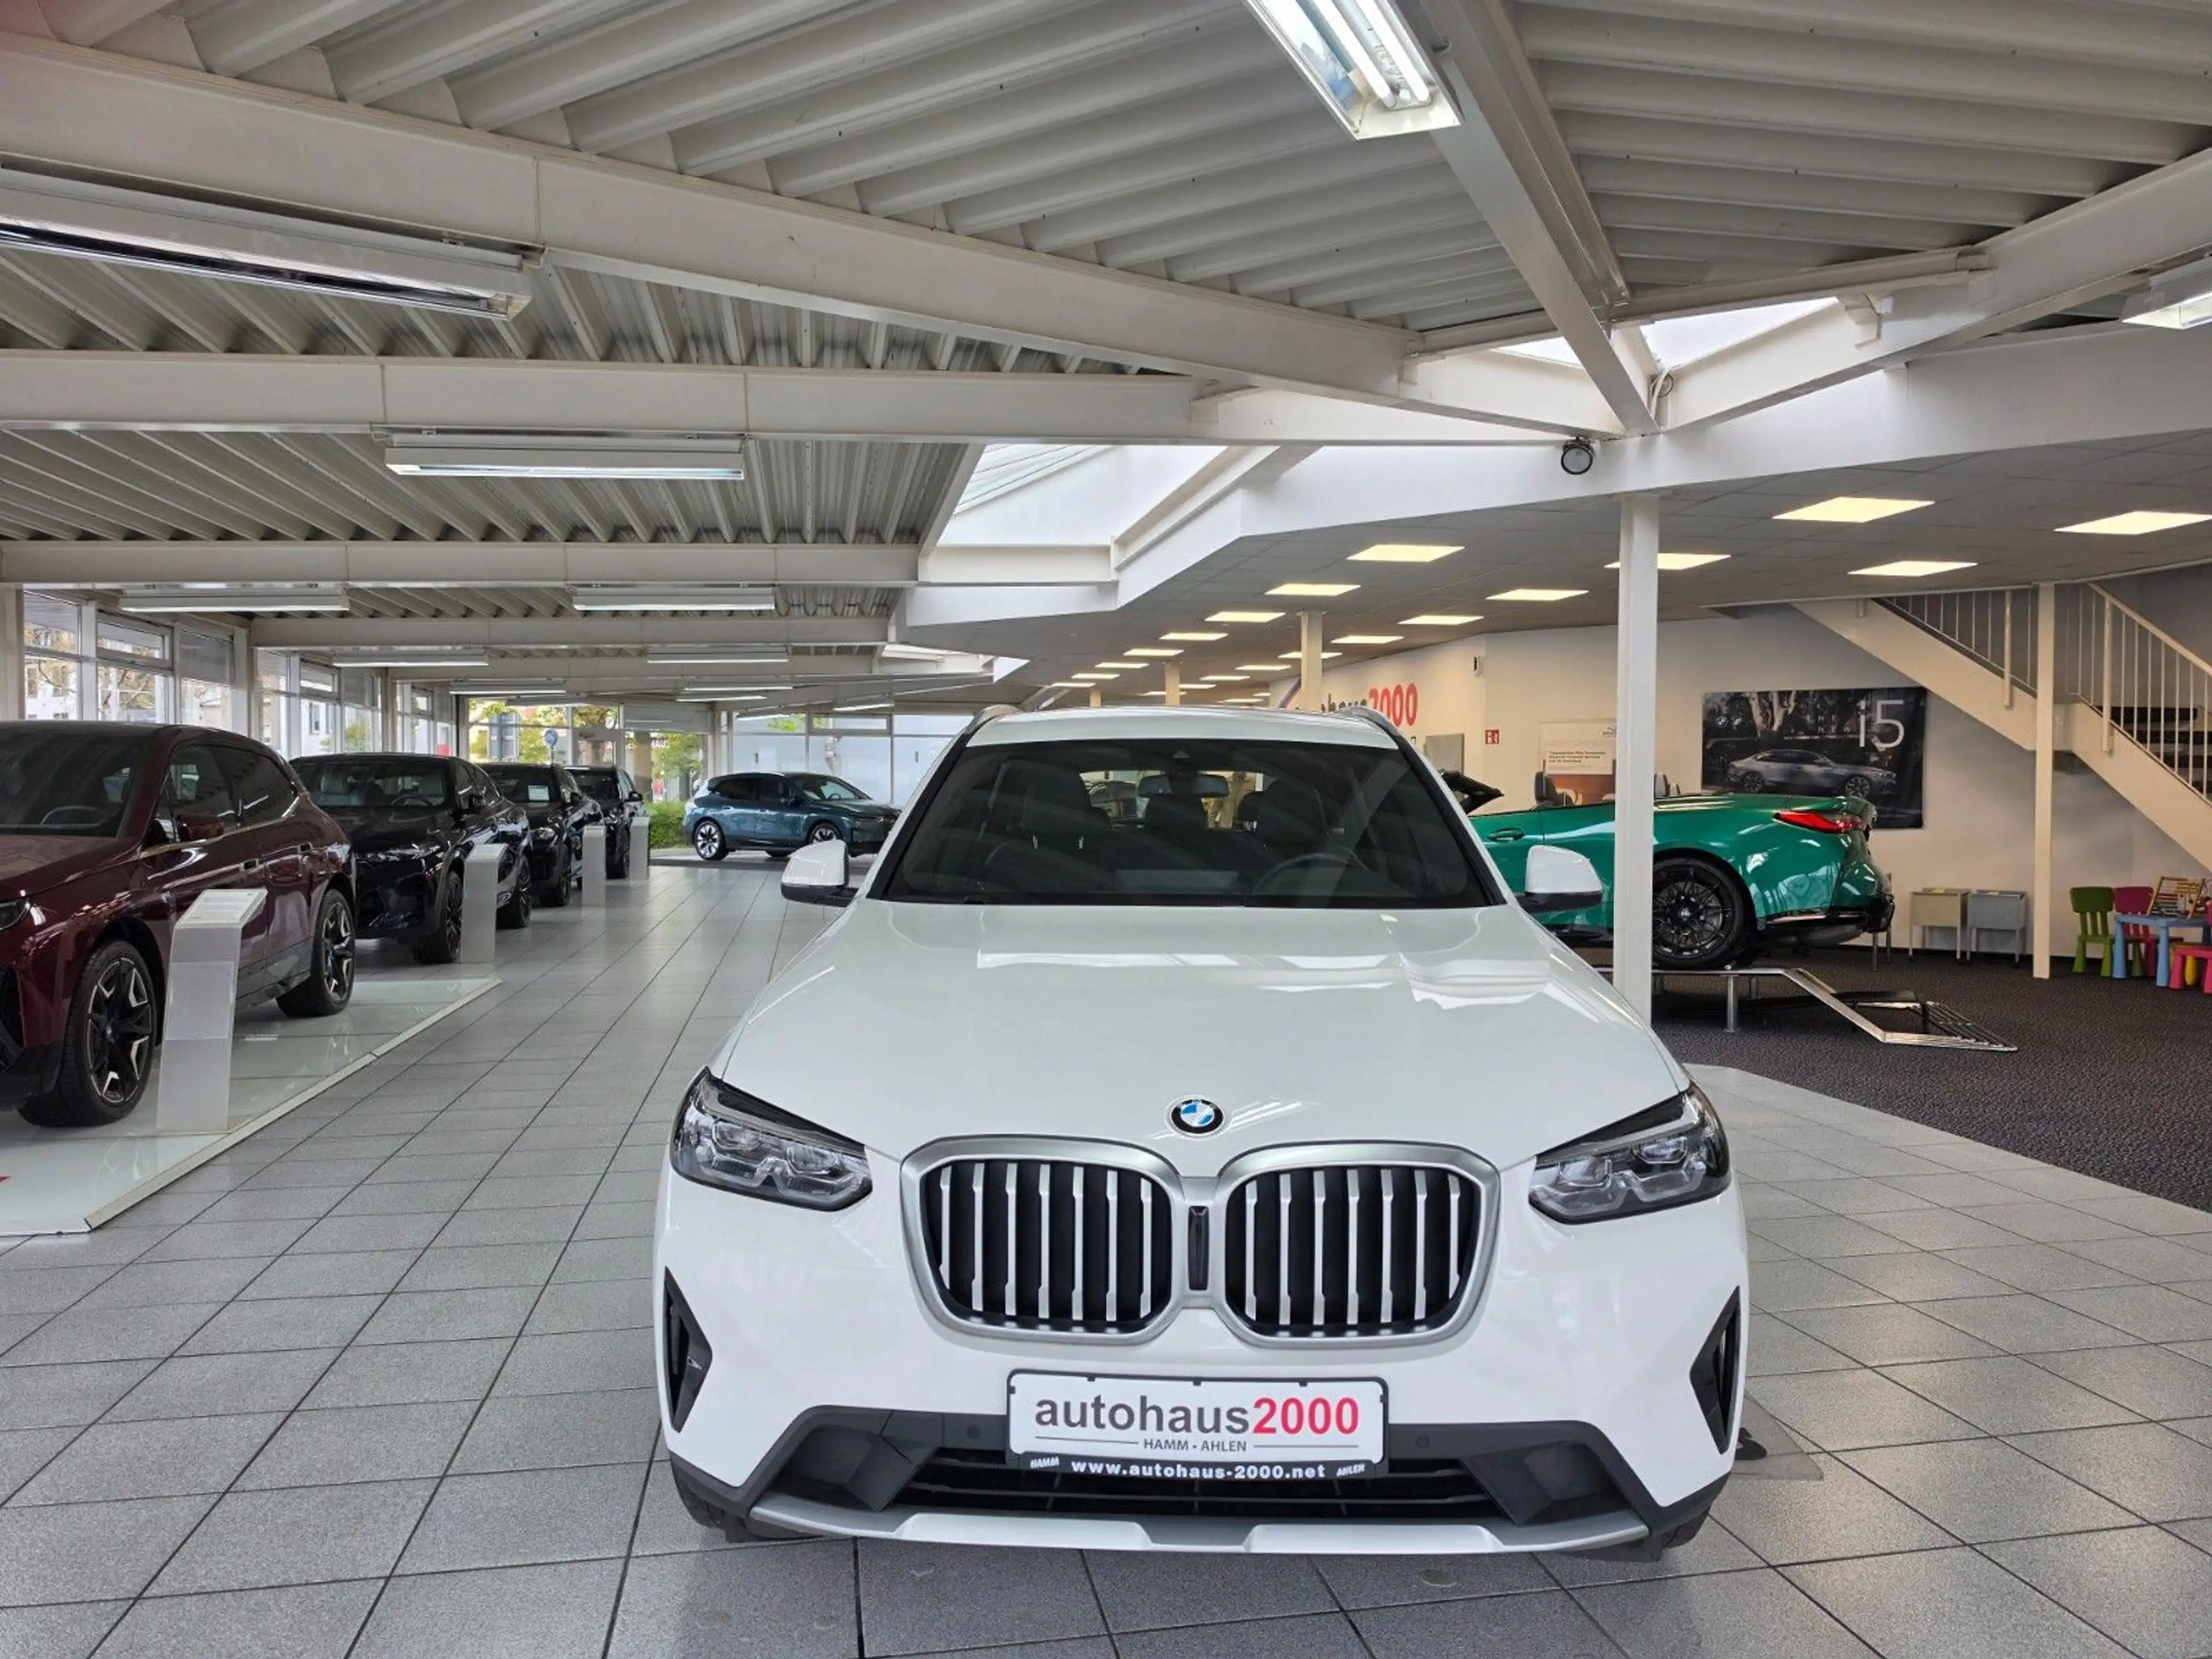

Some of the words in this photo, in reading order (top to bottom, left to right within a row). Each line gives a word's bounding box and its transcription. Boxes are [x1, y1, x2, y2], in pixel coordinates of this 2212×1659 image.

[1035, 1394, 1359, 1434] autohaus2000
[1144, 1438, 1189, 1451] HAMM
[1200, 1440, 1247, 1452] AHLEN
[1030, 1456, 1060, 1469] HAMM
[1071, 1461, 1325, 1479] www.autohaus-2000.net
[1336, 1463, 1366, 1477] AHLEN
